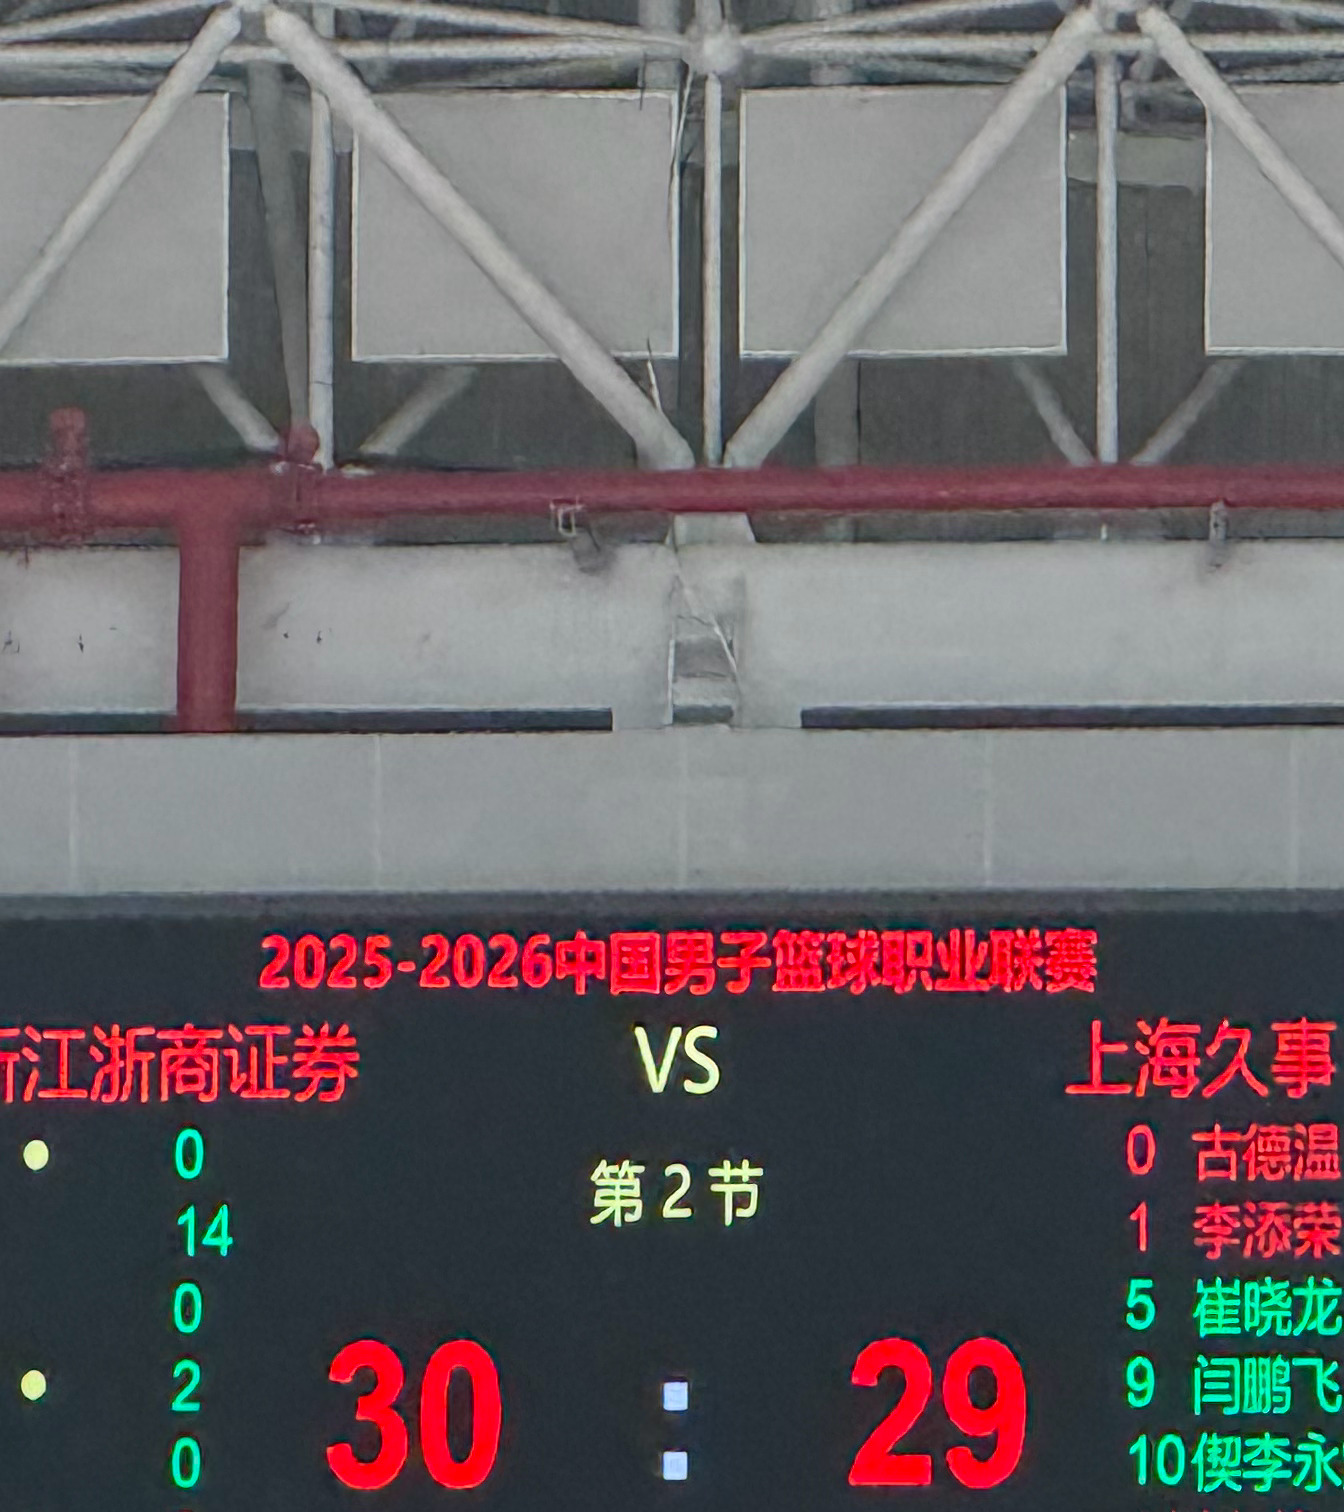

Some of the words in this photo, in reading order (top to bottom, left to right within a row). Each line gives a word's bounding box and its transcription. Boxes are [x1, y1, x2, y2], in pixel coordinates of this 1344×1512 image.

[258, 927, 1099, 996] 2025-2026中国男子篮球职业联赛
[633, 1025, 720, 1095] VS
[1064, 1016, 1337, 1099] 上海久事
[175, 1129, 204, 1179] 0
[1126, 1123, 1156, 1174] 0
[1192, 1123, 1342, 1182] 古德温
[178, 1204, 233, 1257] 14
[1130, 1202, 1148, 1252] 1
[1193, 1202, 1342, 1260] 李添荣
[174, 1283, 202, 1333] 0
[1126, 1276, 1155, 1330] 5
[1193, 1276, 1343, 1338] 崔晓龙
[172, 1359, 200, 1411] 2
[325, 1339, 503, 1491] 30
[847, 1336, 1027, 1490] 29
[1126, 1354, 1154, 1407] 9
[1194, 1354, 1342, 1415] 闫鹏飞
[172, 1438, 200, 1488] 0
